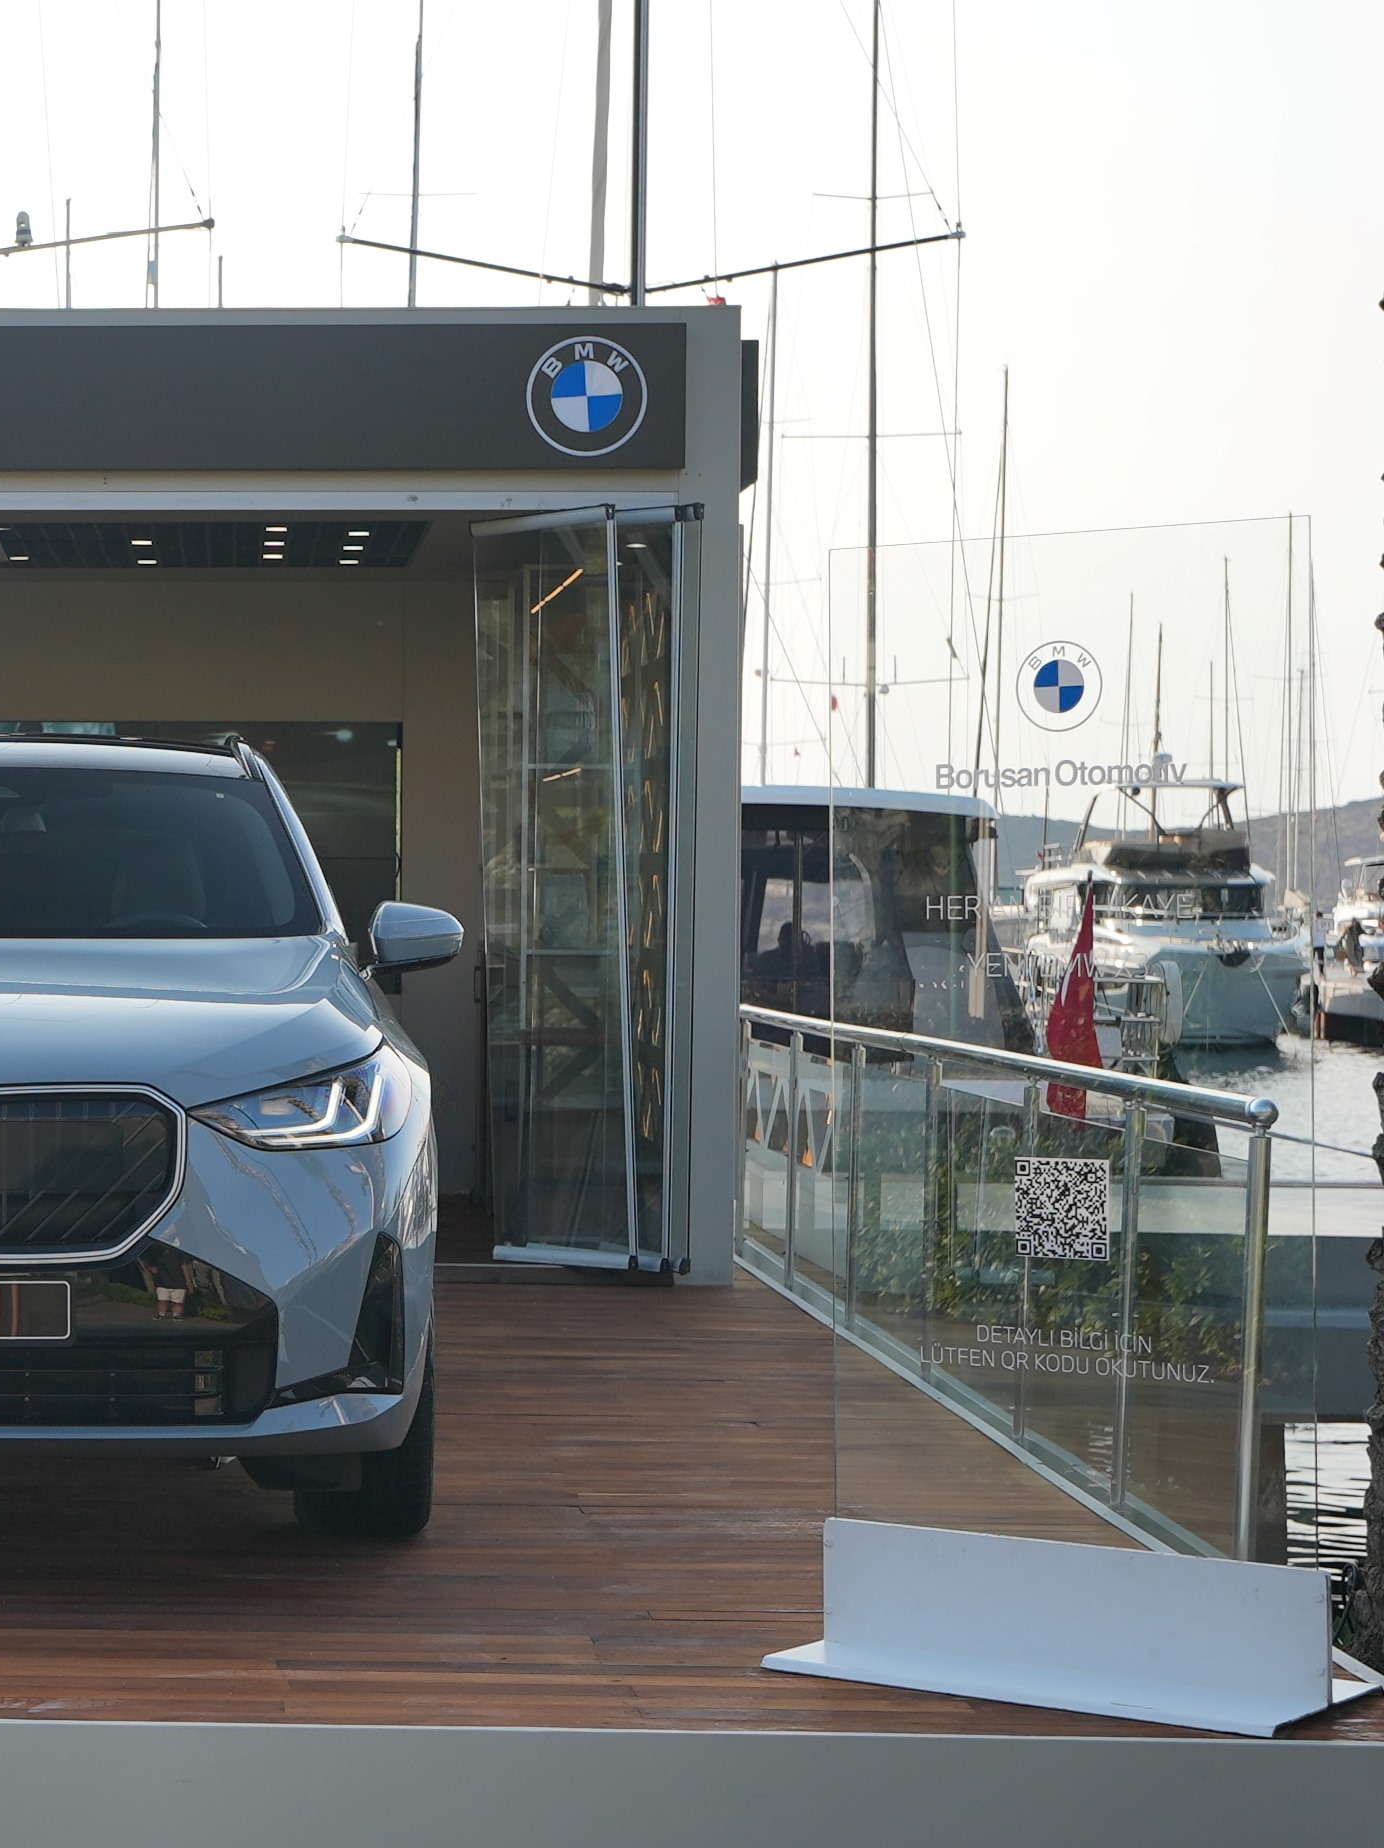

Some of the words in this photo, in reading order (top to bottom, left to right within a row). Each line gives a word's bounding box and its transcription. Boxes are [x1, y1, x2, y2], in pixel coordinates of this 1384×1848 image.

[541, 343, 630, 379] BMW
[1028, 645, 1092, 671] BMW
[935, 762, 1051, 790] Borusan
[1054, 758, 1188, 787] Otomotiv
[925, 894, 982, 921] HER
[976, 1324, 1055, 1348] DETAYLI
[1059, 1326, 1109, 1351] BİLGİ
[919, 1342, 995, 1368] LÜTFEN
[1000, 1350, 1030, 1372] QR
[1034, 1352, 1090, 1376] KODU
[1095, 1356, 1216, 1385] OKUTUNUZ.
